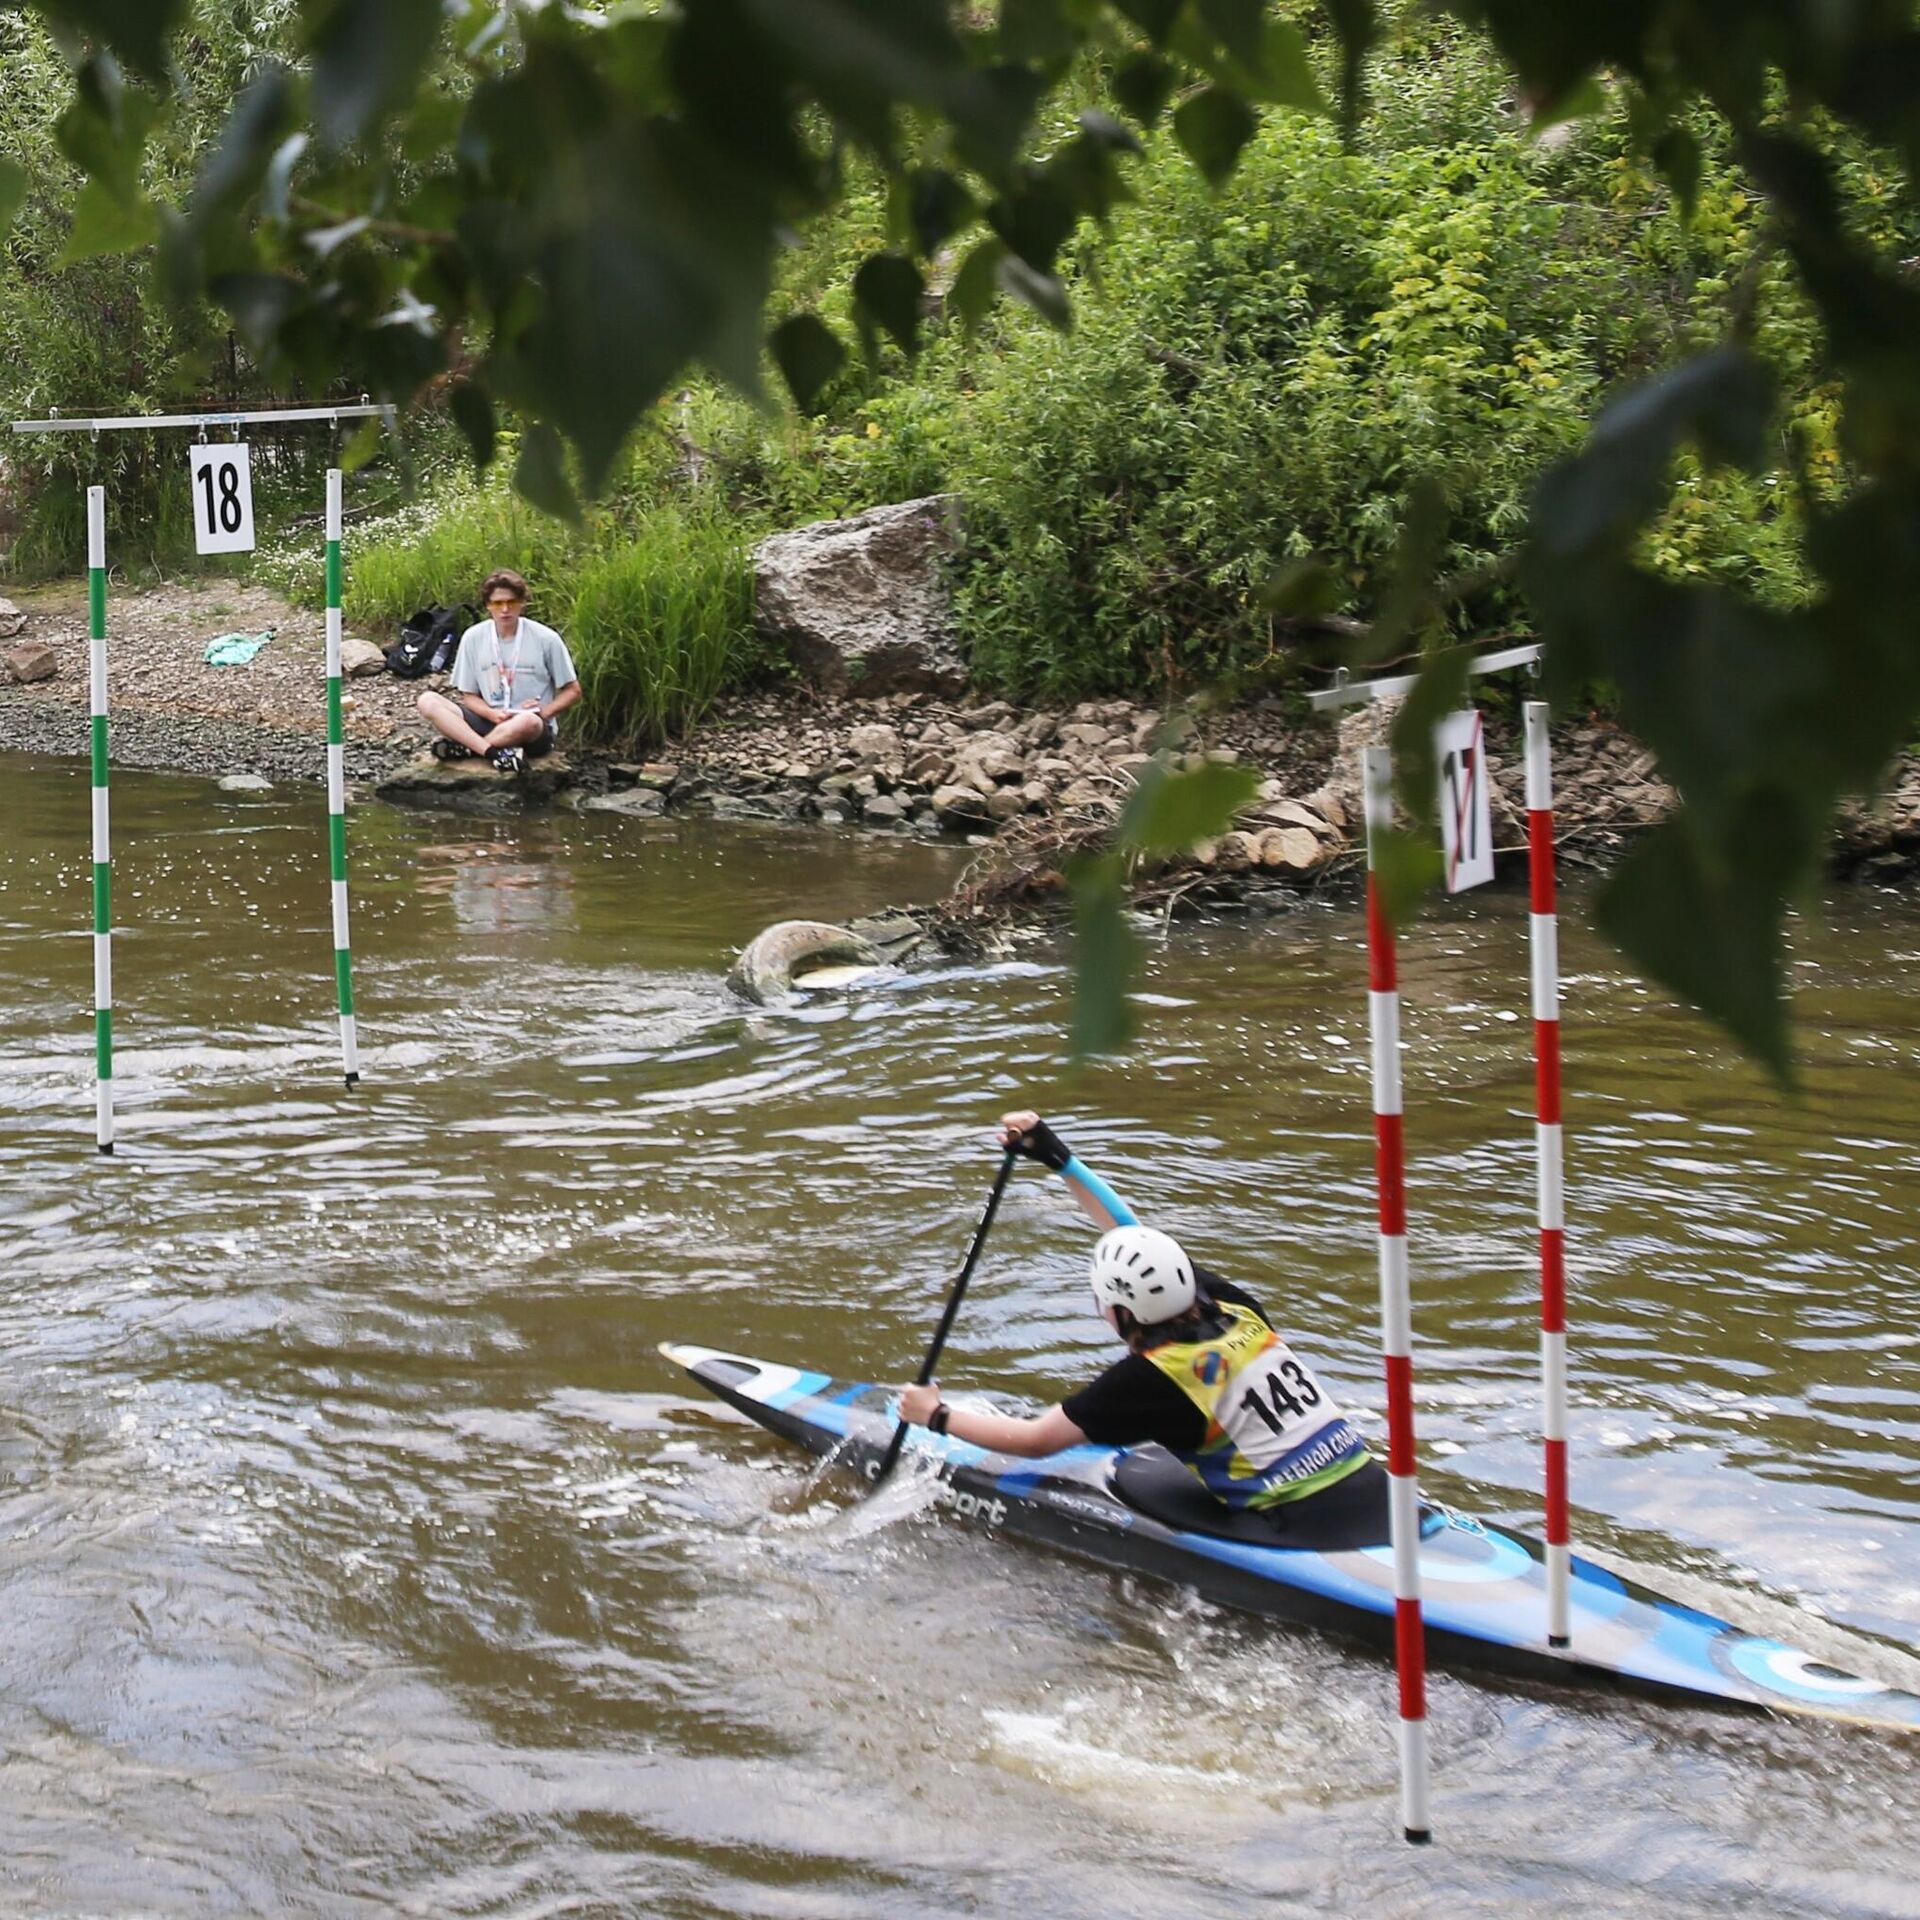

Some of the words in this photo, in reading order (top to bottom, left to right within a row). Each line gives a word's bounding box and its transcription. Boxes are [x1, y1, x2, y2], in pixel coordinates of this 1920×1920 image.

[197, 462, 242, 534] 18
[1443, 747, 1477, 863] 17
[1240, 1360, 1321, 1437] 143
